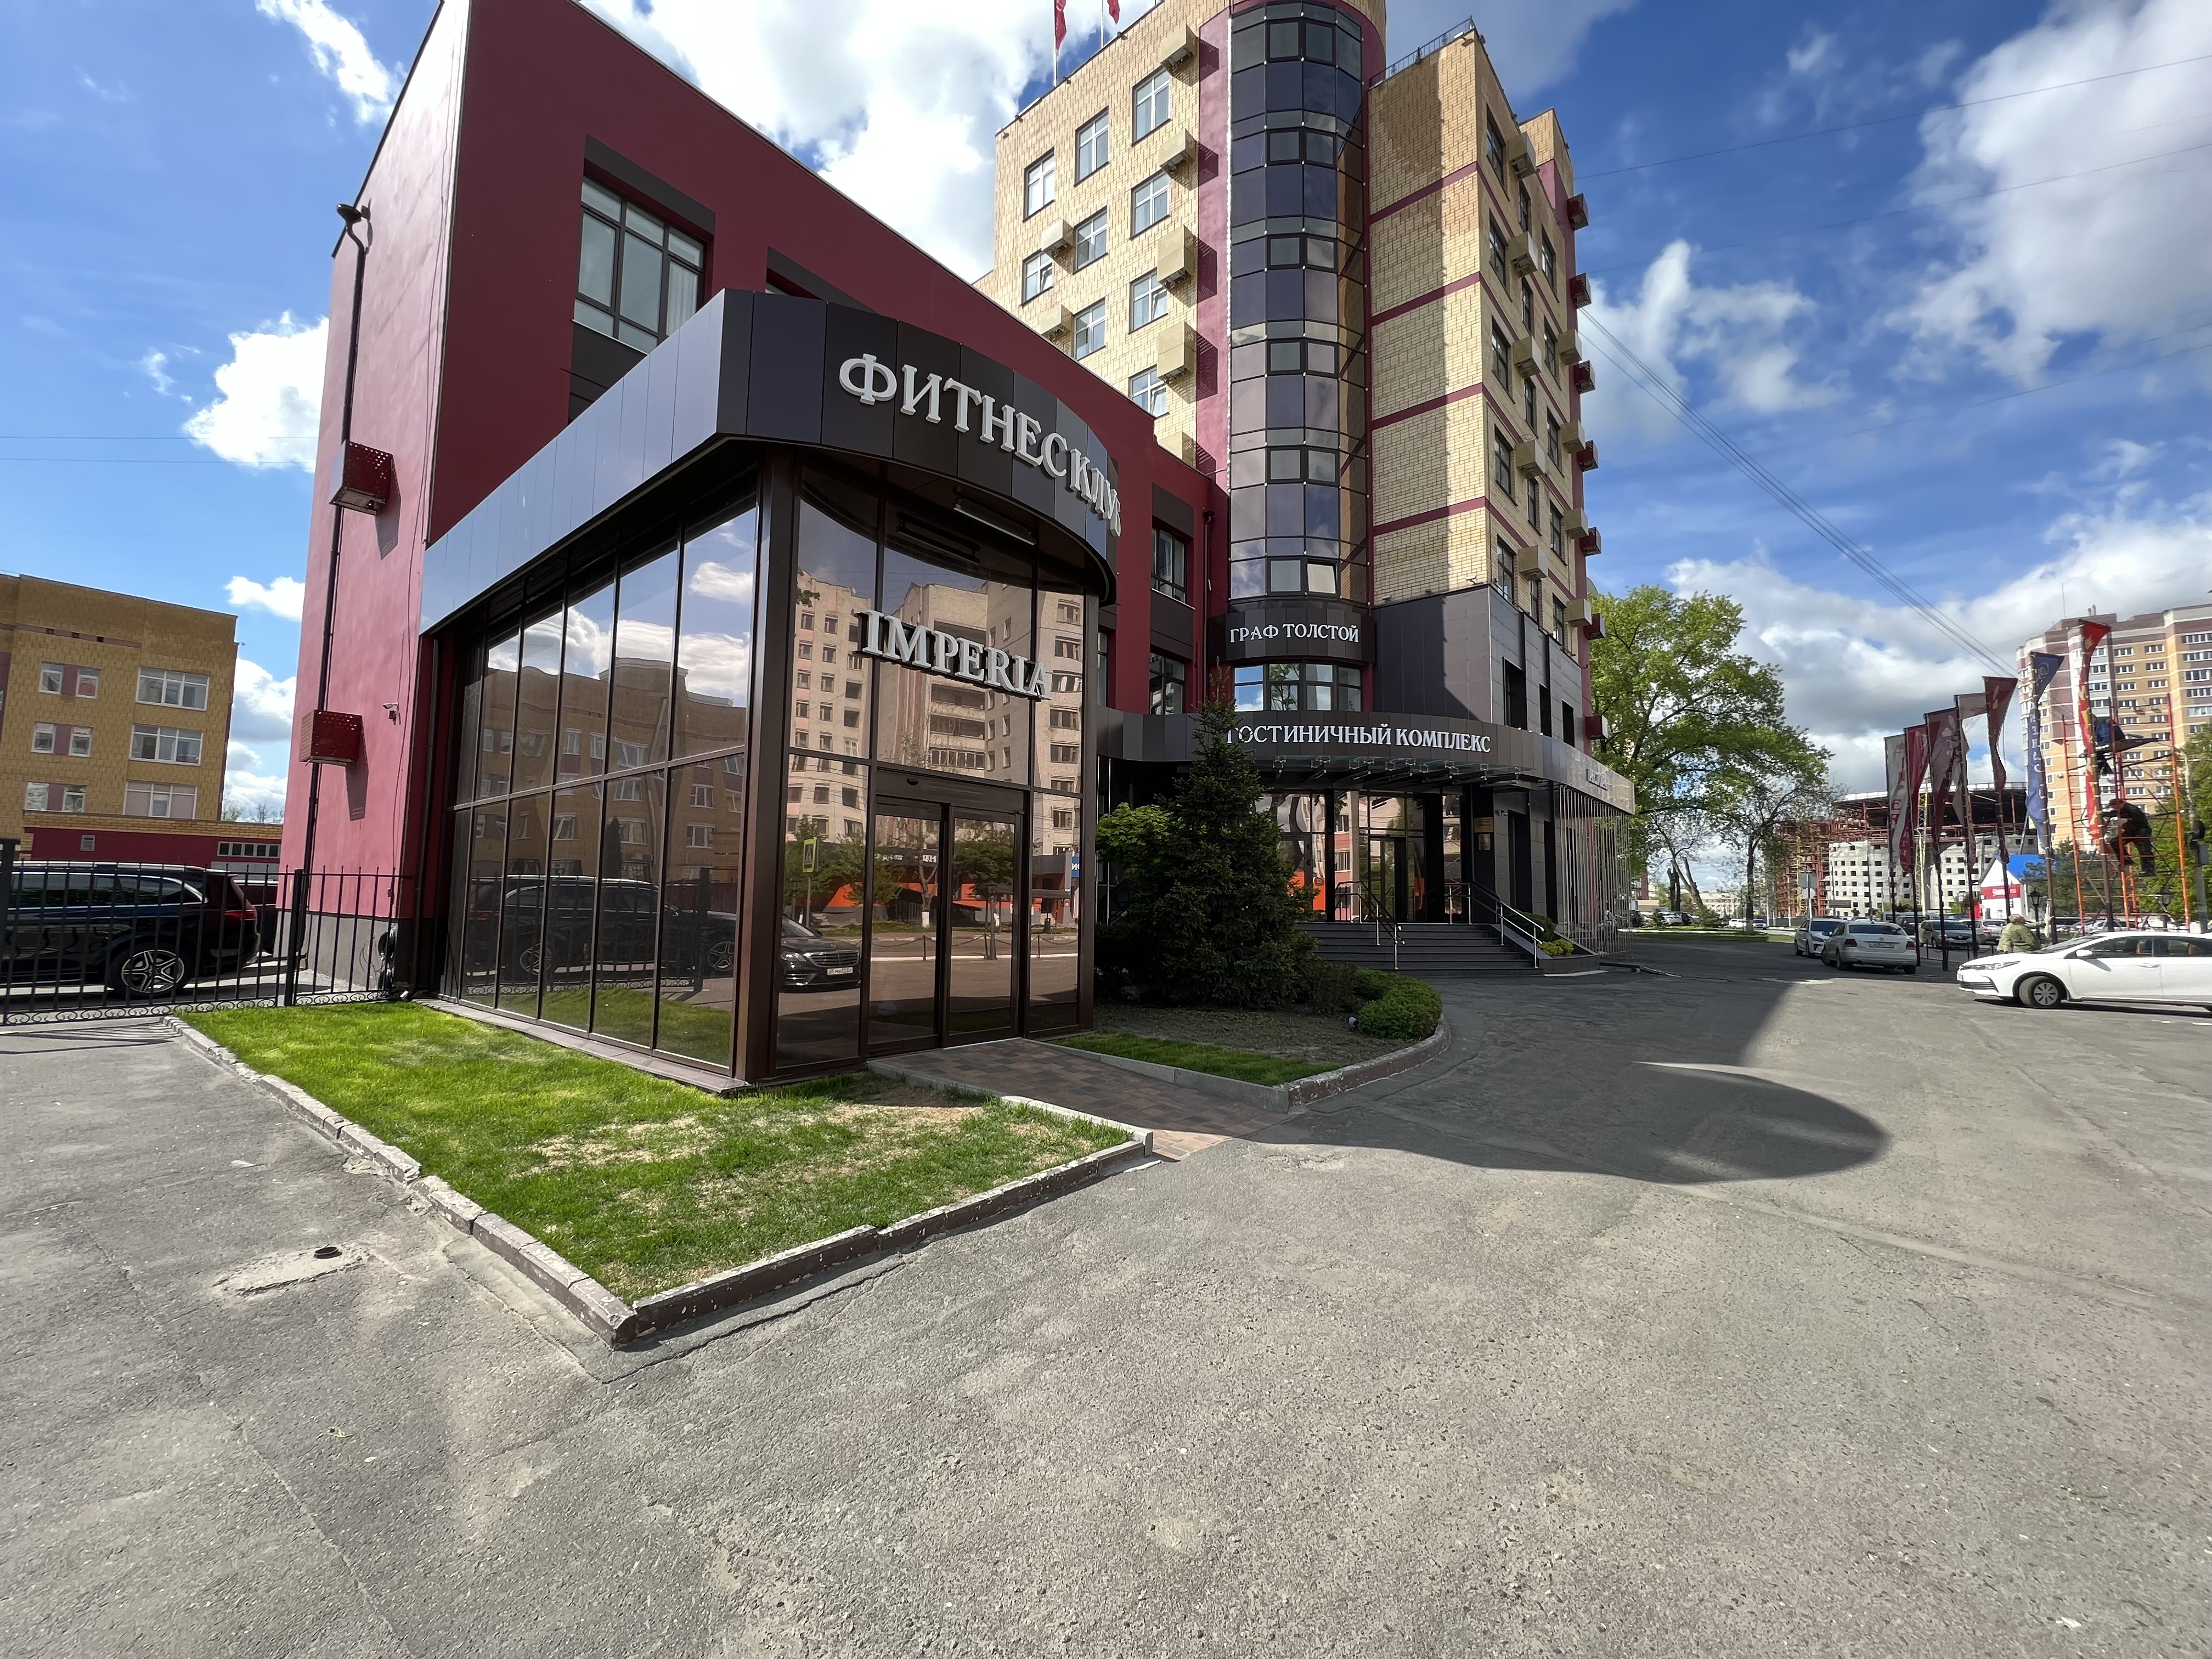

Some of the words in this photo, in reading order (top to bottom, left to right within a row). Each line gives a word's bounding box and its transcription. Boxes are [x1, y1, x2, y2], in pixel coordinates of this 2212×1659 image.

[839, 353, 1068, 478] ФИТНЕС
[862, 609, 1052, 700] IMPERIA
[1230, 624, 1279, 643] ГРАФ
[1282, 623, 1359, 642] ТОЛСТОЙ
[1395, 728, 1491, 753] КОМПЛЕКС
